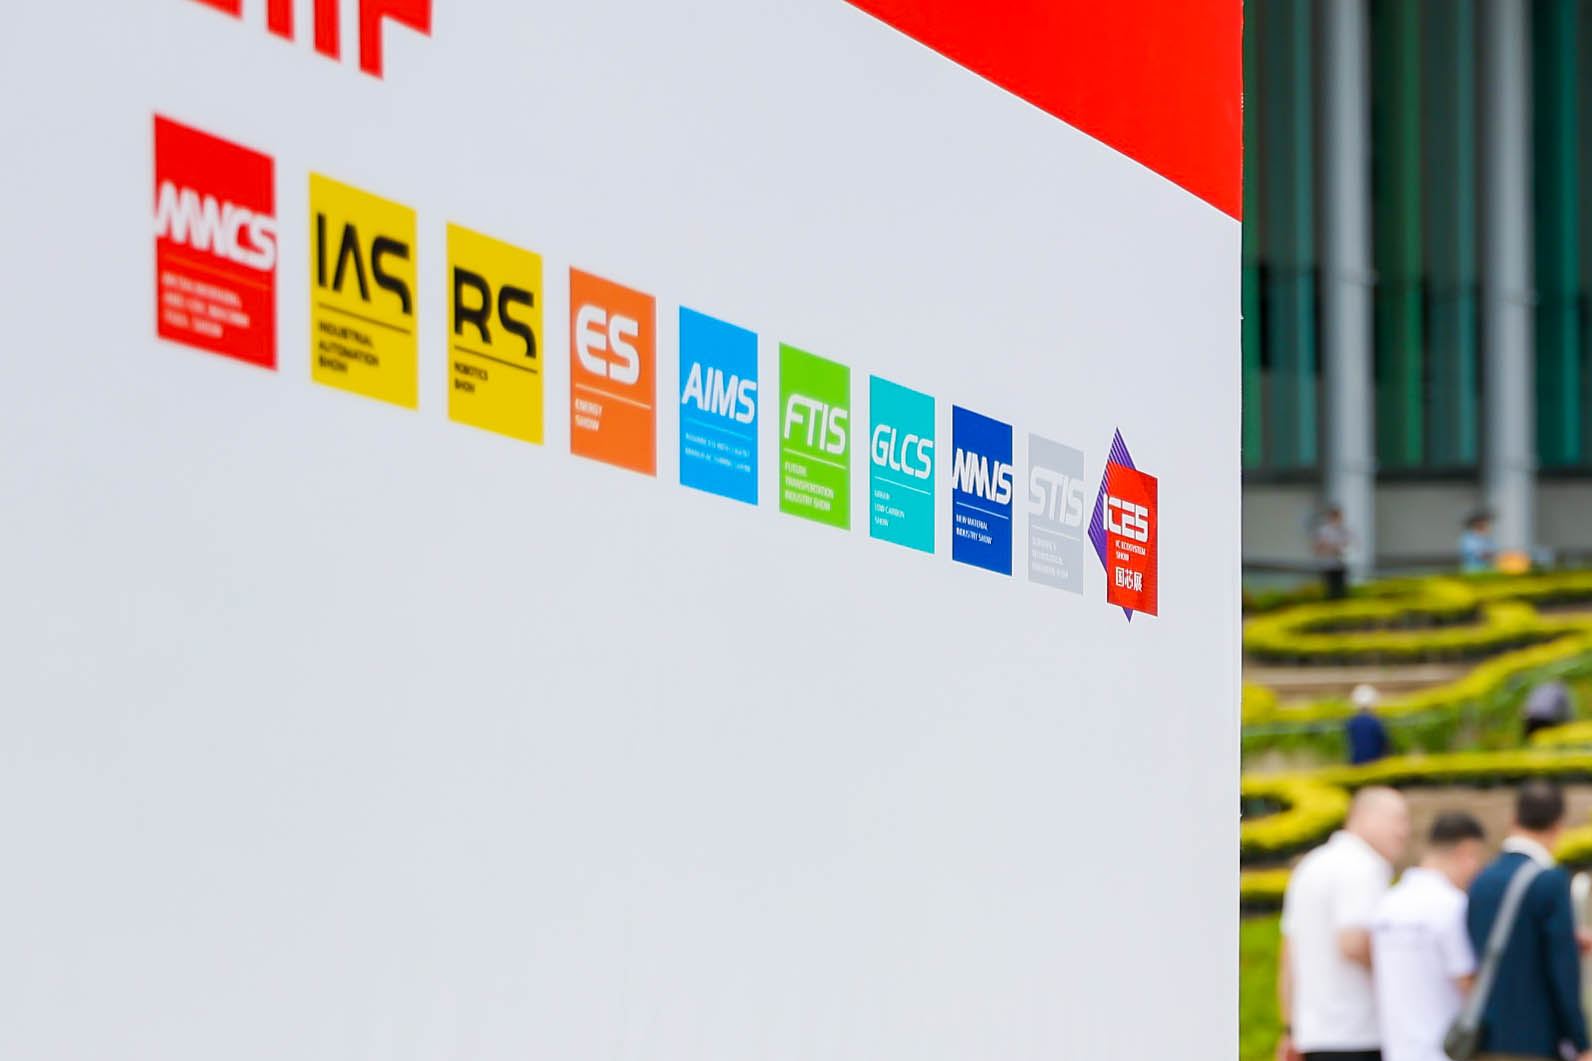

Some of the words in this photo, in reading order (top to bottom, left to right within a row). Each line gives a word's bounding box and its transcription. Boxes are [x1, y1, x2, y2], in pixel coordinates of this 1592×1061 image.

[317, 212, 412, 316] IAS
[454, 264, 536, 359] RS
[576, 304, 640, 384] ES
[682, 361, 757, 424] AIMS
[784, 393, 848, 455] FTIS
[872, 424, 933, 479] GLCS
[1028, 465, 1086, 528] STIS
[1103, 493, 1149, 543] ICES
[1115, 566, 1143, 592] 国芯展
